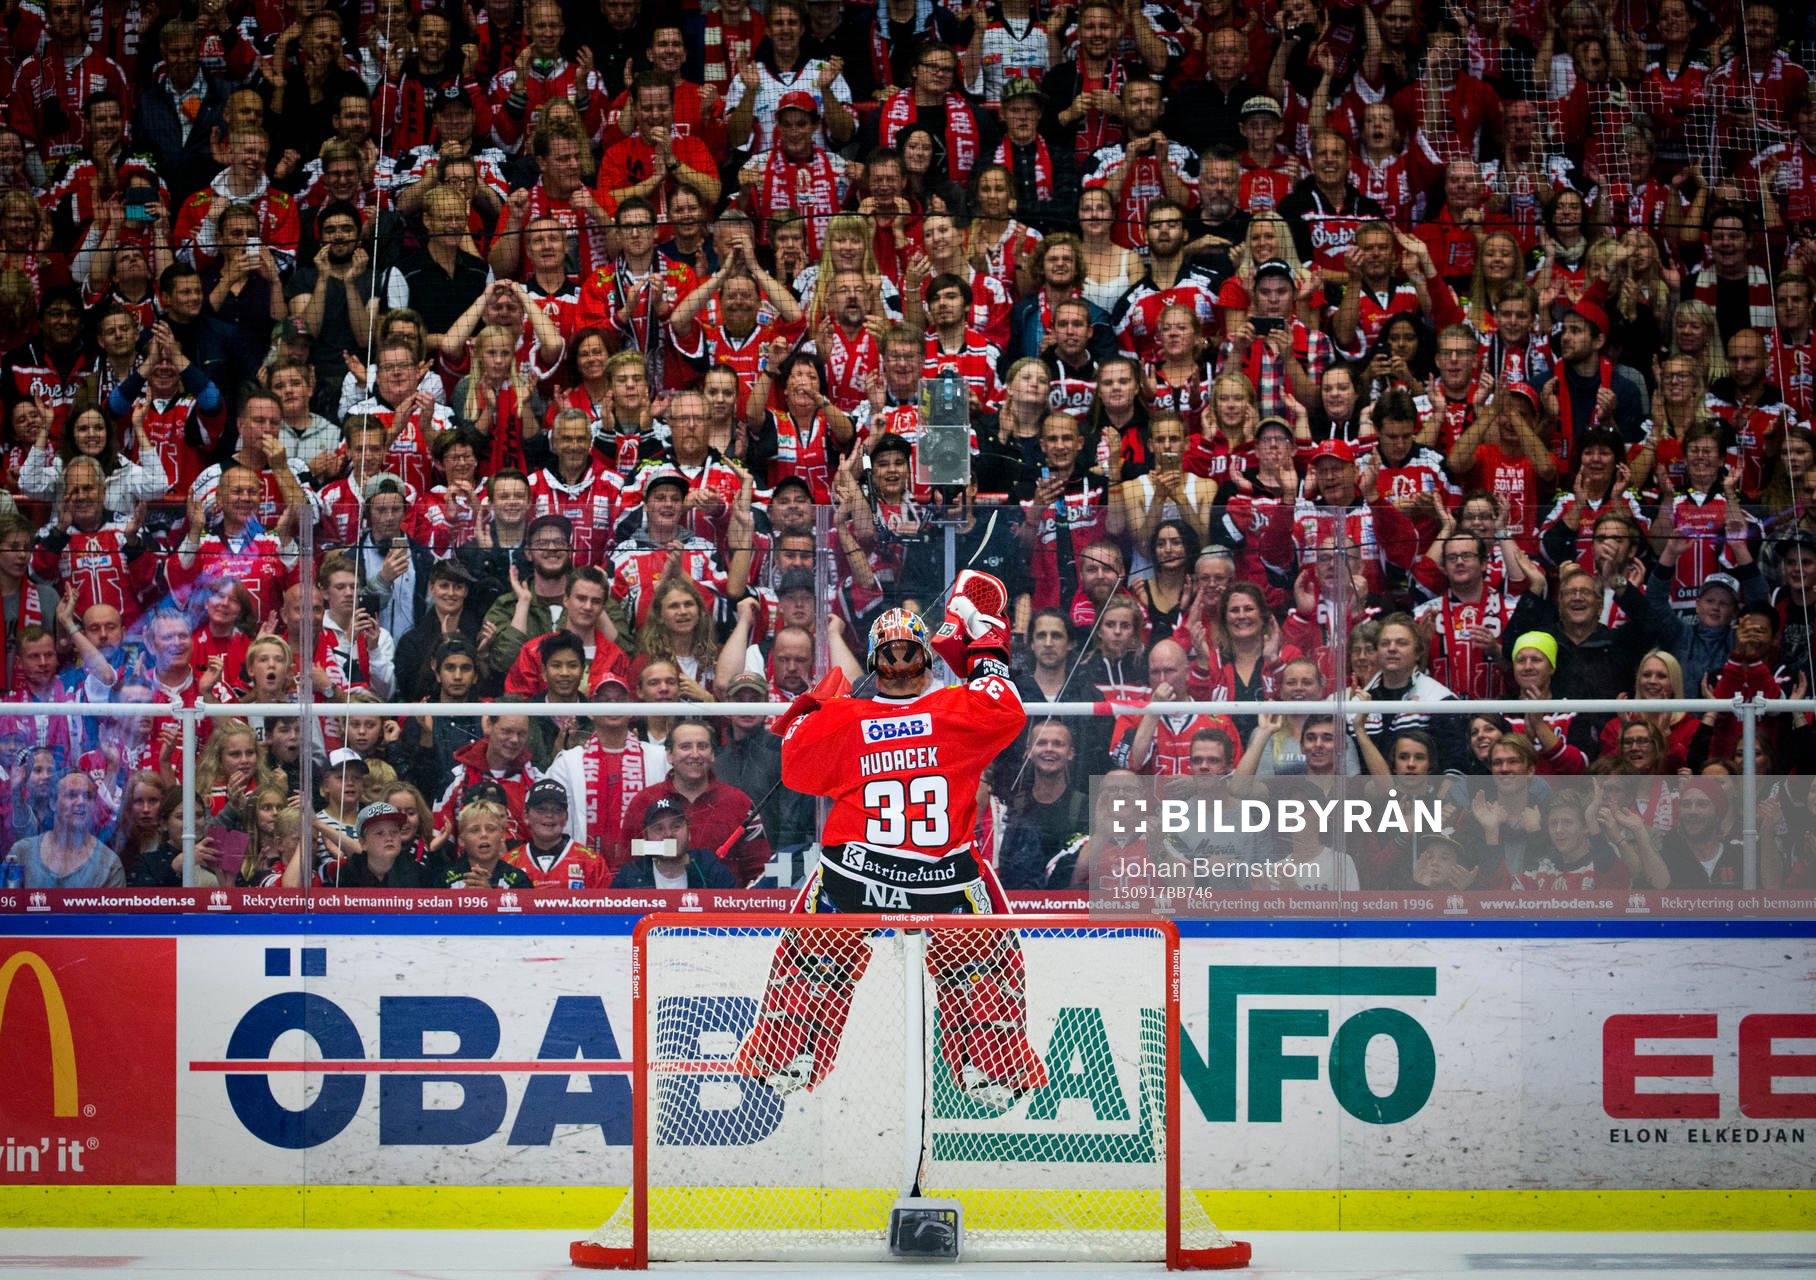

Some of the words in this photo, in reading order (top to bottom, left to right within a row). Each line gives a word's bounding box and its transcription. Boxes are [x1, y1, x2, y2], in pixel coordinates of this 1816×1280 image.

[1311, 222, 1356, 248] Örebr
[868, 719, 925, 741] ÖBAB
[859, 746, 938, 777] HUDACEK
[863, 774, 950, 847] 33
[842, 844, 956, 883] Katrinelund
[63, 895, 196, 908] www.kornboden.se
[242, 894, 315, 910] Rekrytering
[319, 895, 340, 908] och
[344, 895, 413, 911] bemanning
[417, 896, 452, 909] sedan
[457, 897, 489, 909] 1996
[533, 896, 667, 909] www.kornboden.se
[713, 896, 785, 911] Rekrytering
[862, 882, 911, 910] NA
[1008, 898, 1140, 910] www.kornboden.se
[1480, 898, 1614, 910] www.kornboden.se
[1660, 897, 1734, 912] Rekrytering
[1737, 897, 1760, 911] och
[1187, 897, 1260, 912] Rekrytering
[1263, 898, 1286, 911] och
[1289, 898, 1359, 913] bemanning
[1362, 898, 1398, 911] sedan
[1402, 898, 1434, 910] 1996
[909, 914, 935, 923] Sport
[633, 974, 641, 999] Sport
[225, 948, 785, 1149] ÖBAB
[1610, 1128, 1668, 1143] ELON
[1687, 1128, 1805, 1143] ELKEDJAN
[0, 1137, 50, 1172] in’
